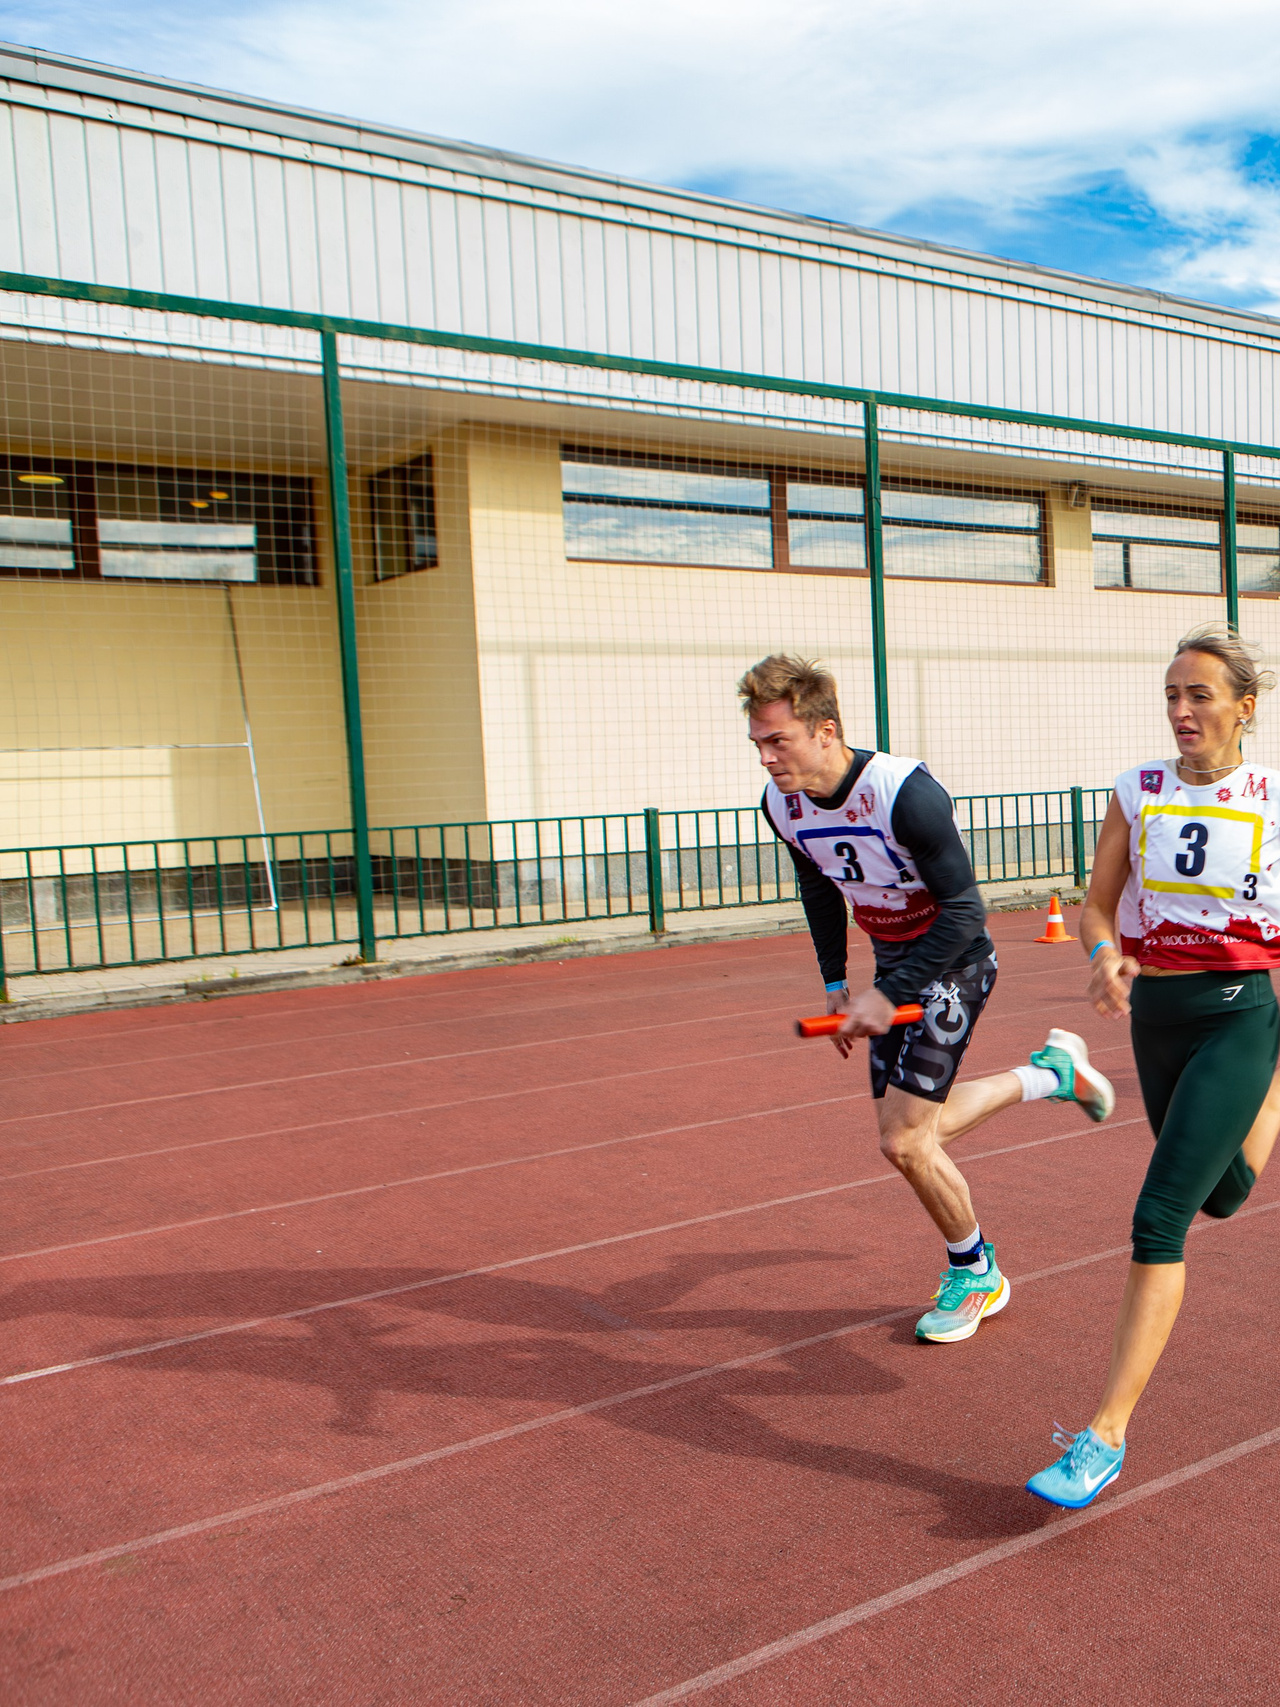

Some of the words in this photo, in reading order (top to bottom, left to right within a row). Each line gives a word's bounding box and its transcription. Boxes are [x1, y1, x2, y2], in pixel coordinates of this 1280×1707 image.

[834, 842, 864, 882] 3
[1175, 822, 1208, 877] 3
[899, 870, 915, 883] 4
[1243, 873, 1257, 900] 3
